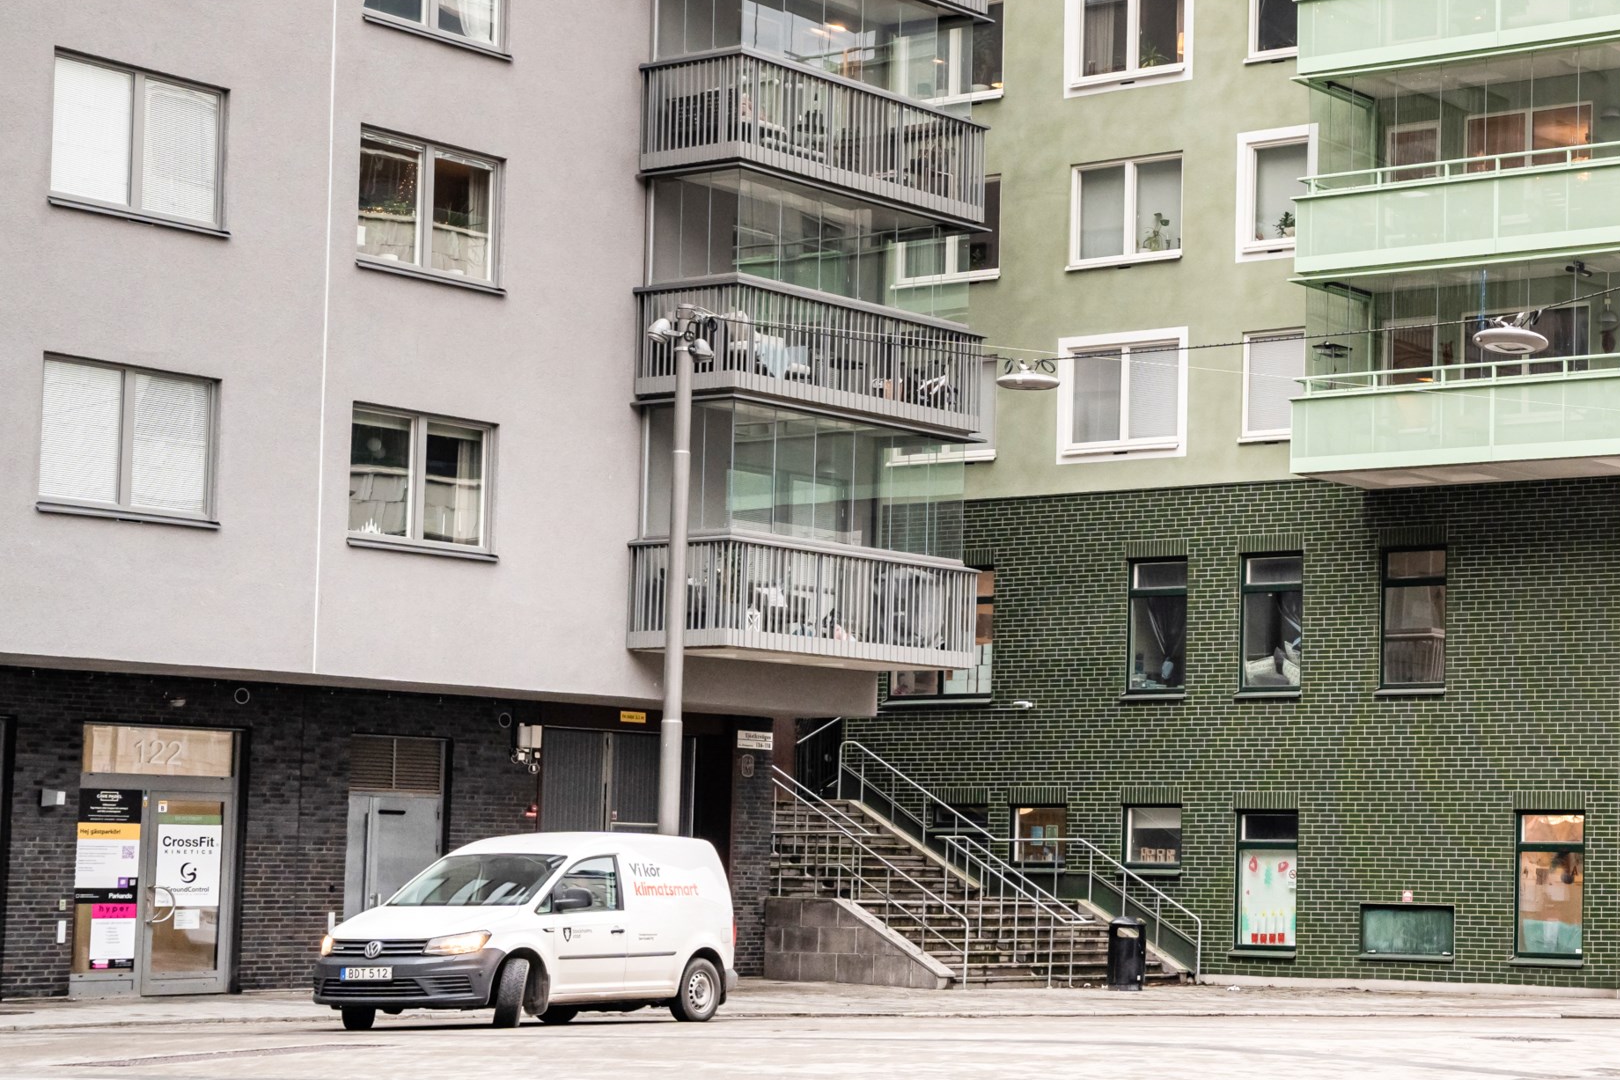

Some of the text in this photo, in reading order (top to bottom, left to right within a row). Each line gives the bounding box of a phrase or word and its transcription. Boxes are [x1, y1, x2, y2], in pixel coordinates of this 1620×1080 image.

[134, 739, 181, 765] 122
[162, 835, 215, 847] CrossFit
[628, 863, 642, 877] Vi
[633, 881, 699, 896] klimatsmart
[98, 905, 129, 913] hyper
[348, 969, 388, 978] BDT 512
